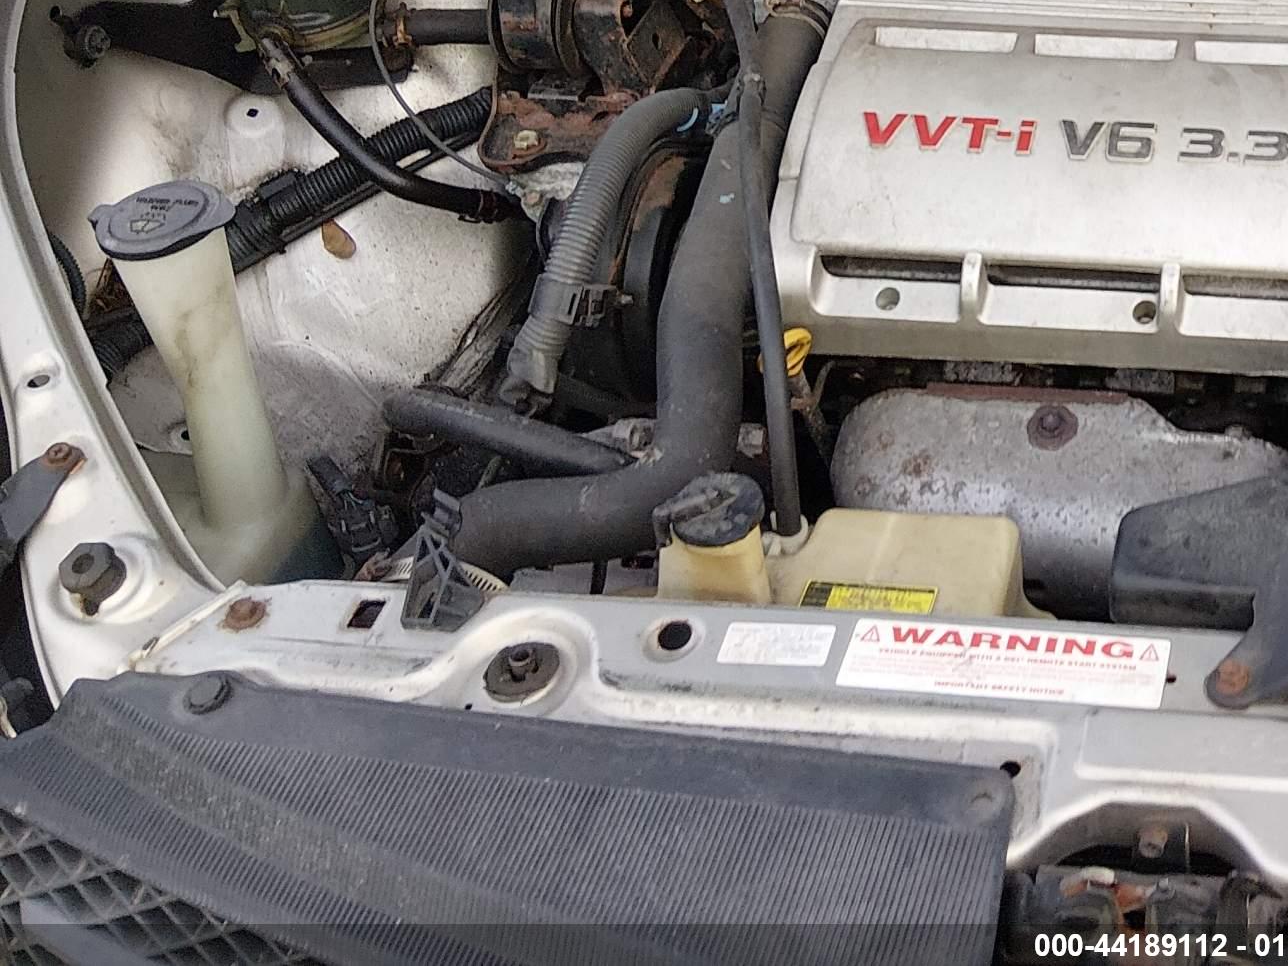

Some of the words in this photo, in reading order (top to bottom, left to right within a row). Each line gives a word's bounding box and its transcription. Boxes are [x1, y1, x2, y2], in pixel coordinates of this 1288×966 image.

[863, 111, 1038, 156] VVT-i
[1058, 119, 1160, 162] V6
[892, 626, 1134, 659] WARNING
